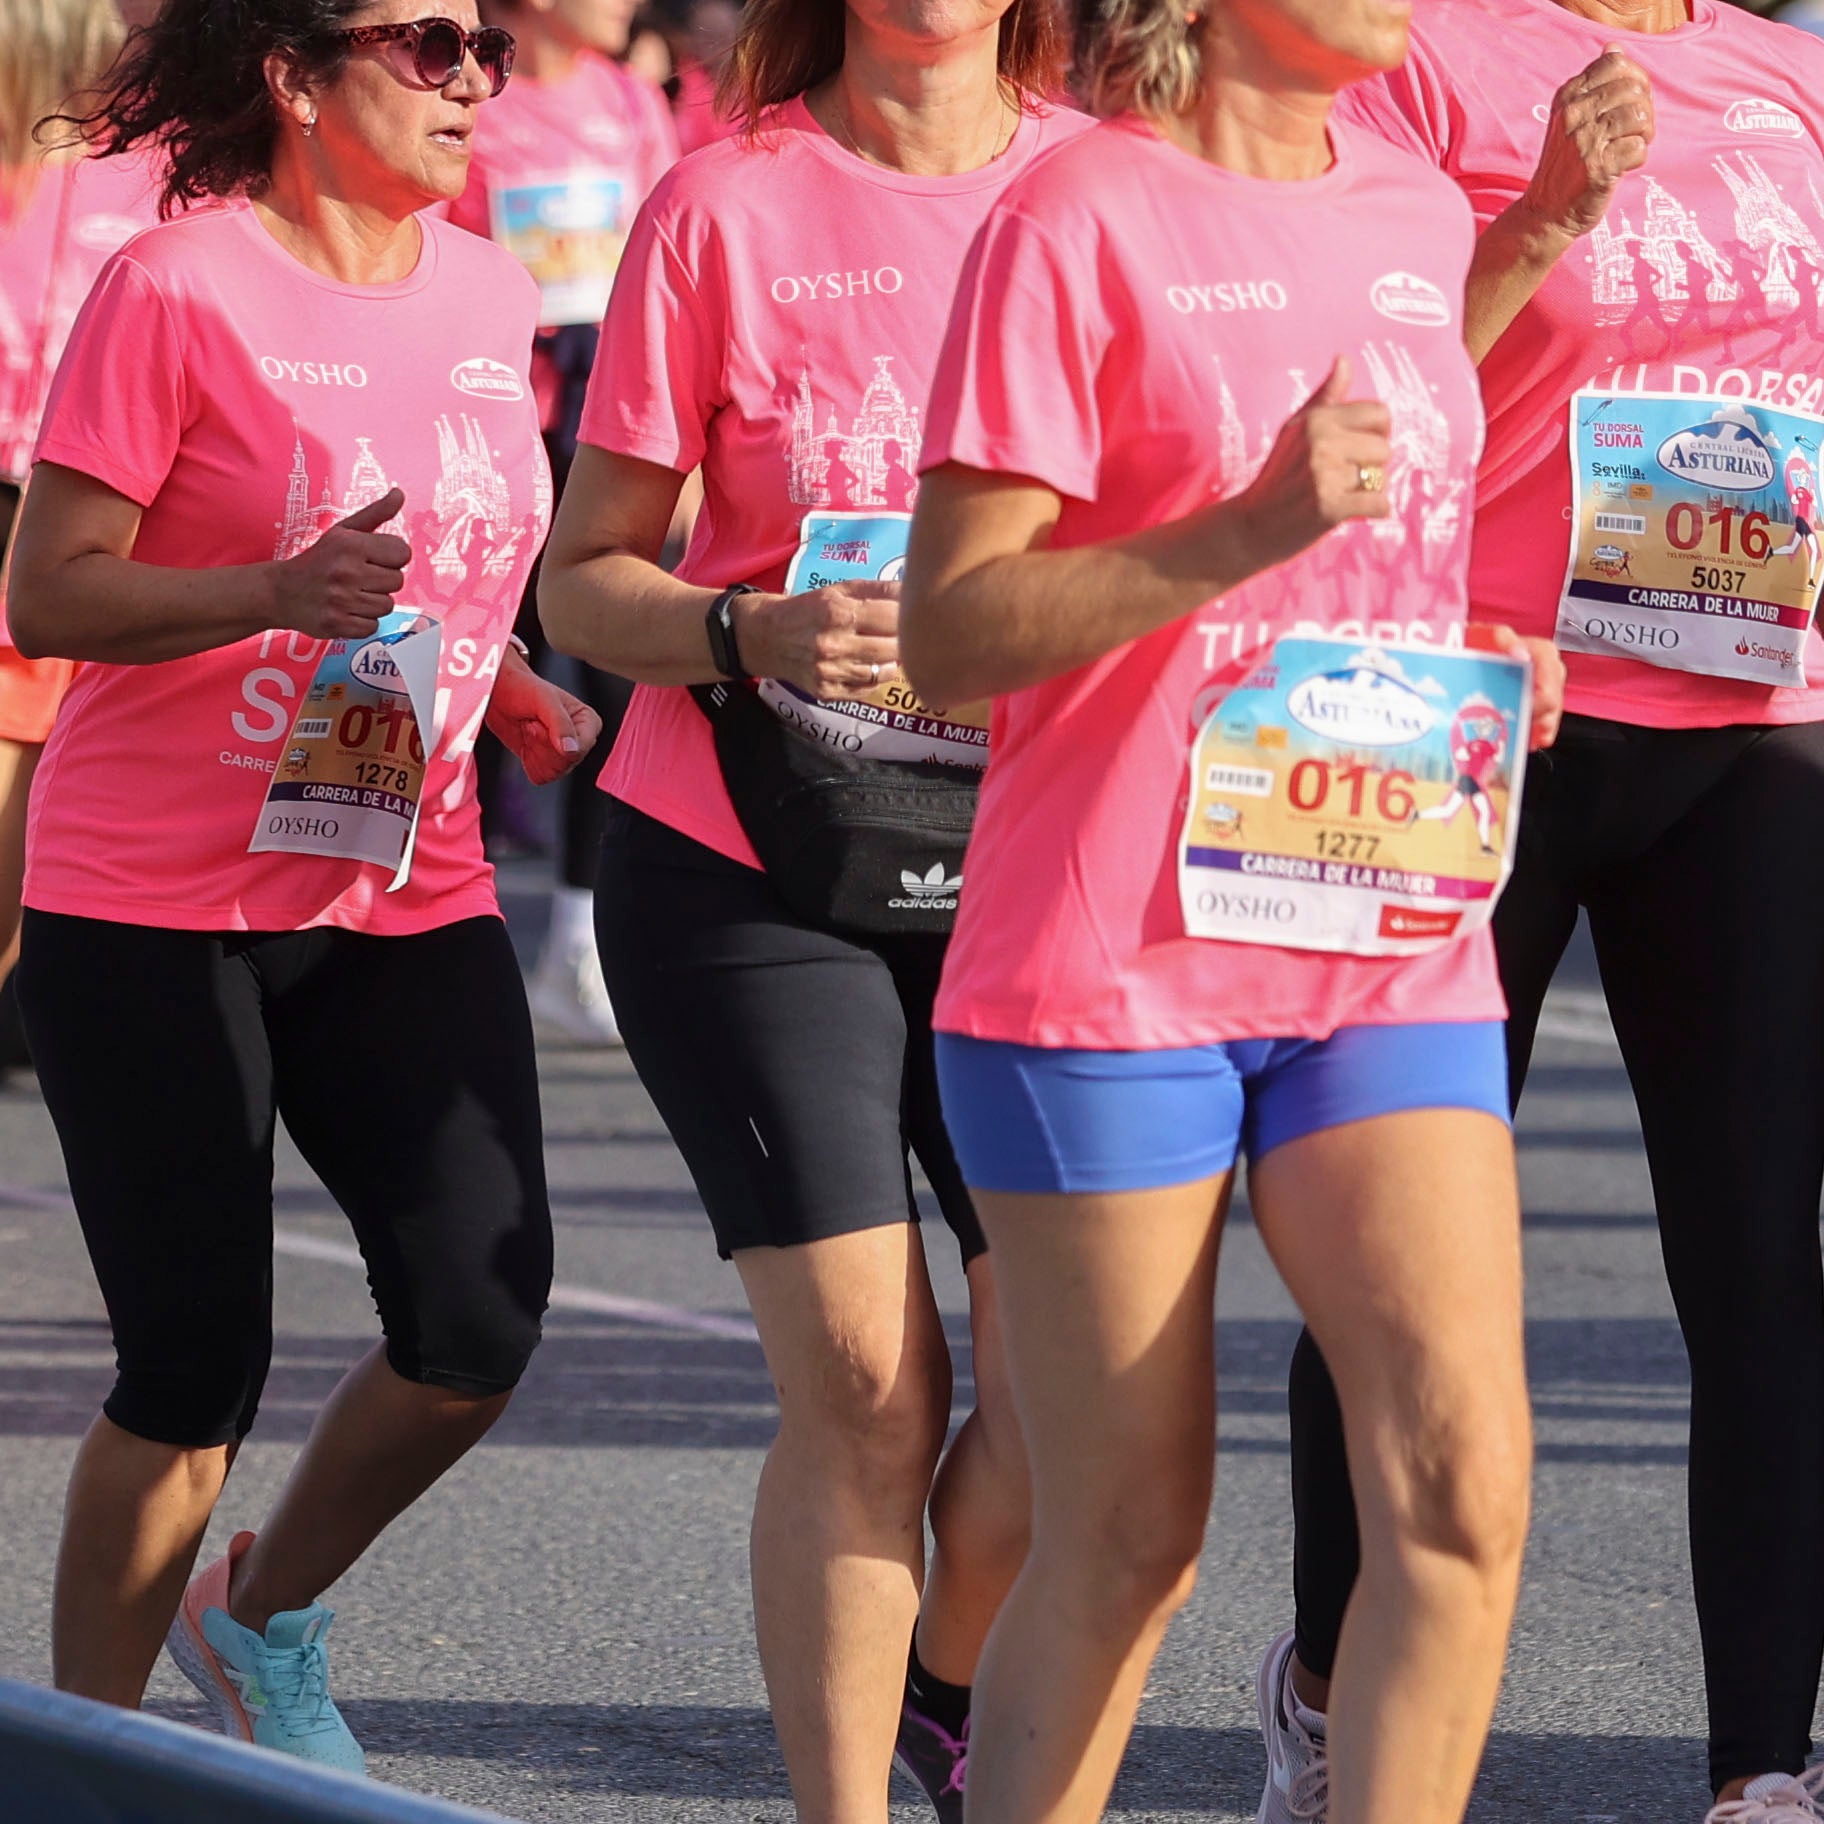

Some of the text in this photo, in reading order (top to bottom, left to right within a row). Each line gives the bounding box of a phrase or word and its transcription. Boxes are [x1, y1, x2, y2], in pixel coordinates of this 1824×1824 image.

[771, 266, 903, 303] OYSHO
[1166, 279, 1287, 313] OYSHO
[260, 355, 368, 388] OYSHO
[1673, 364, 1824, 413] DORSA
[1593, 423, 1644, 434] TU DORSAL
[1593, 432, 1644, 449] SUMA
[1668, 444, 1770, 479] ASTURIANA
[1690, 442, 1732, 452] CENTRAL
[836, 540, 872, 551] DORSAL
[1665, 502, 1771, 559] 016
[819, 550, 869, 565] SUMA
[1691, 566, 1747, 593] 5037
[1628, 588, 1779, 623] CARRERA DE LA MUJER
[1584, 618, 1680, 649] OYSHO
[1751, 642, 1795, 666] Santander
[884, 686, 949, 717] 50
[777, 699, 864, 753] OYSHO
[893, 713, 914, 731] DE
[918, 718, 939, 736] LA
[219, 750, 277, 774] CARRE
[355, 762, 409, 792] 1278
[302, 784, 359, 804] CARRERA
[363, 790, 380, 807] DE
[384, 795, 402, 813] LA
[1286, 758, 1417, 823] 016
[268, 815, 339, 839] OYSHO
[1314, 831, 1382, 861] 1277
[1240, 852, 1437, 896] CARRERA DE LA MUJER
[887, 896, 958, 910] adidas
[1196, 888, 1297, 923] OYSHO
